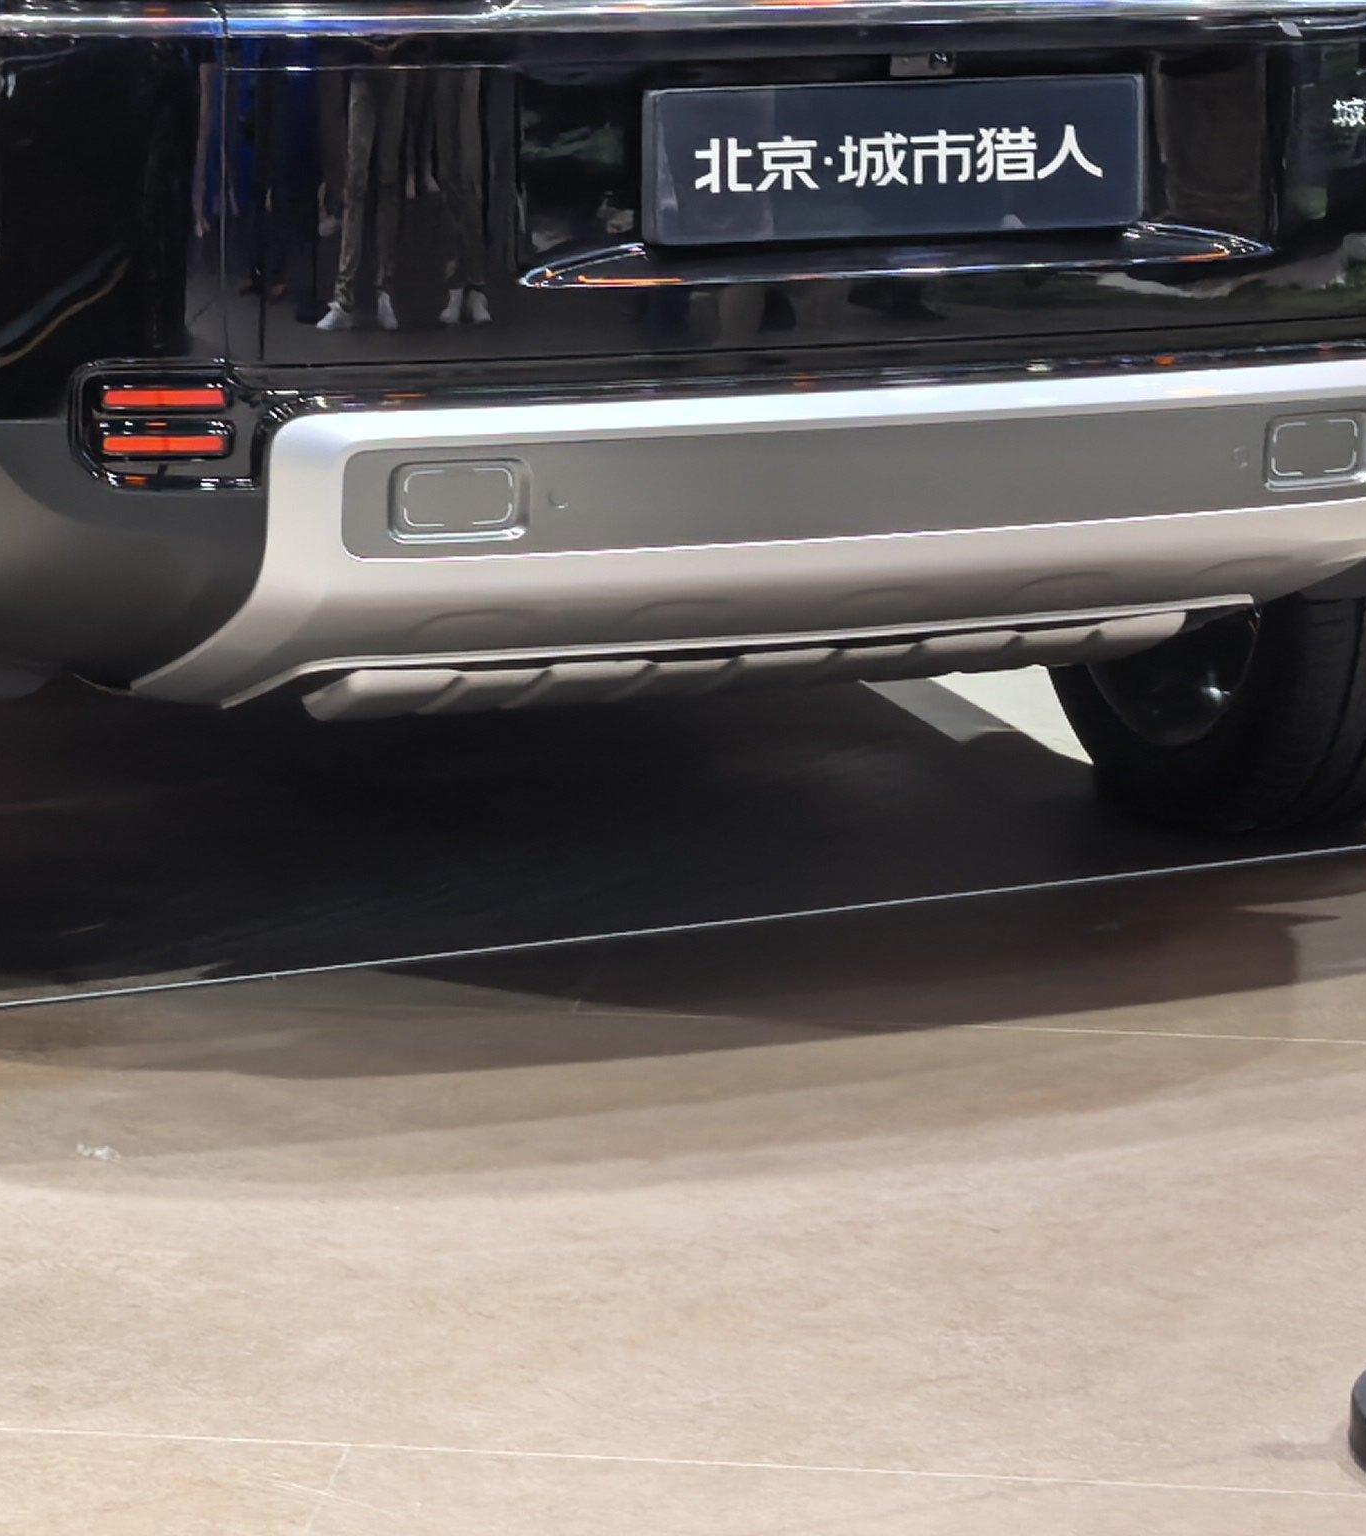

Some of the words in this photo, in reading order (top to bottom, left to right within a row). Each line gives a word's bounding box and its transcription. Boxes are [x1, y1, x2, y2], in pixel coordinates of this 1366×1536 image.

[694, 124, 1104, 195] 北京·城市猎人
